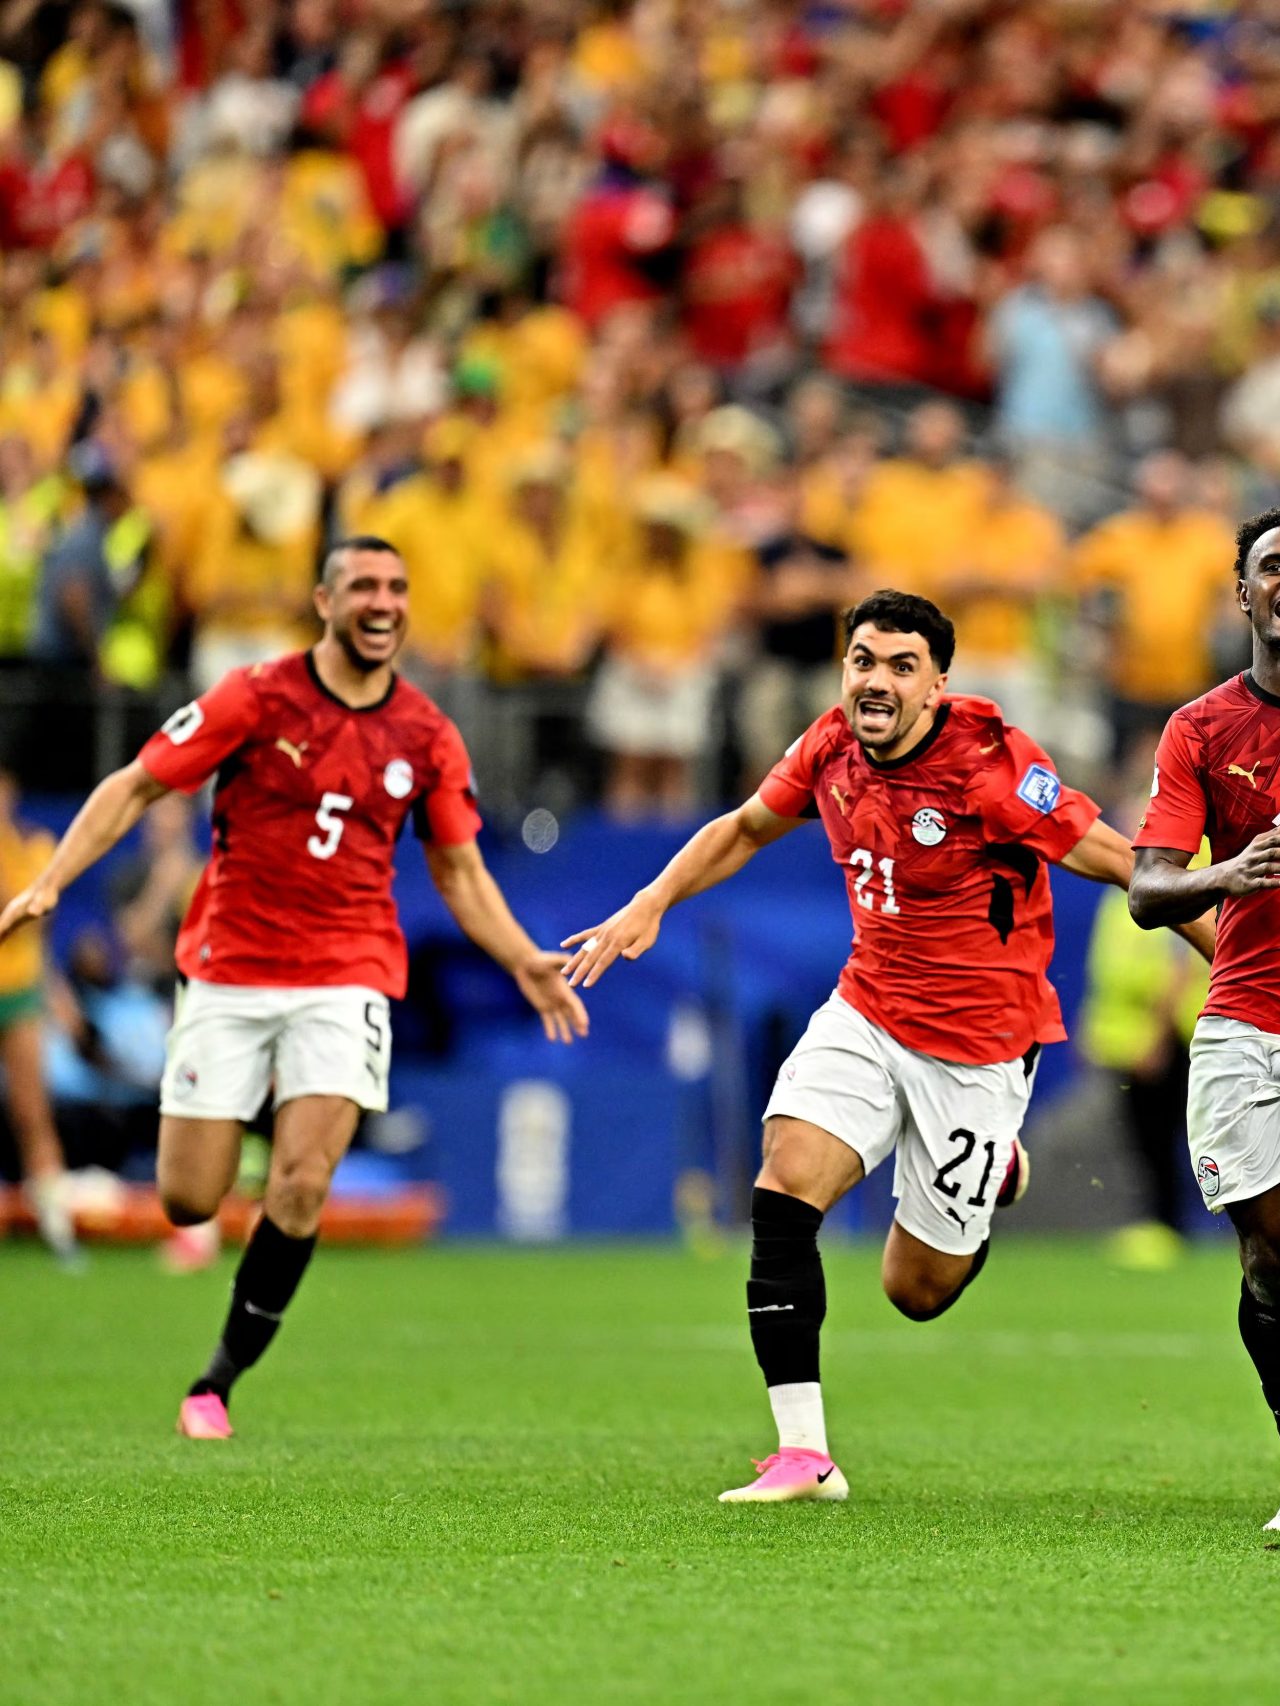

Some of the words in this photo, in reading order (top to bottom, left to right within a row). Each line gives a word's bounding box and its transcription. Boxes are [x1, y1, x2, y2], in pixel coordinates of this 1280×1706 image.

[308, 792, 352, 860] 5
[848, 848, 901, 915] 21
[364, 1001, 384, 1053] 5
[932, 1127, 996, 1207] 21
